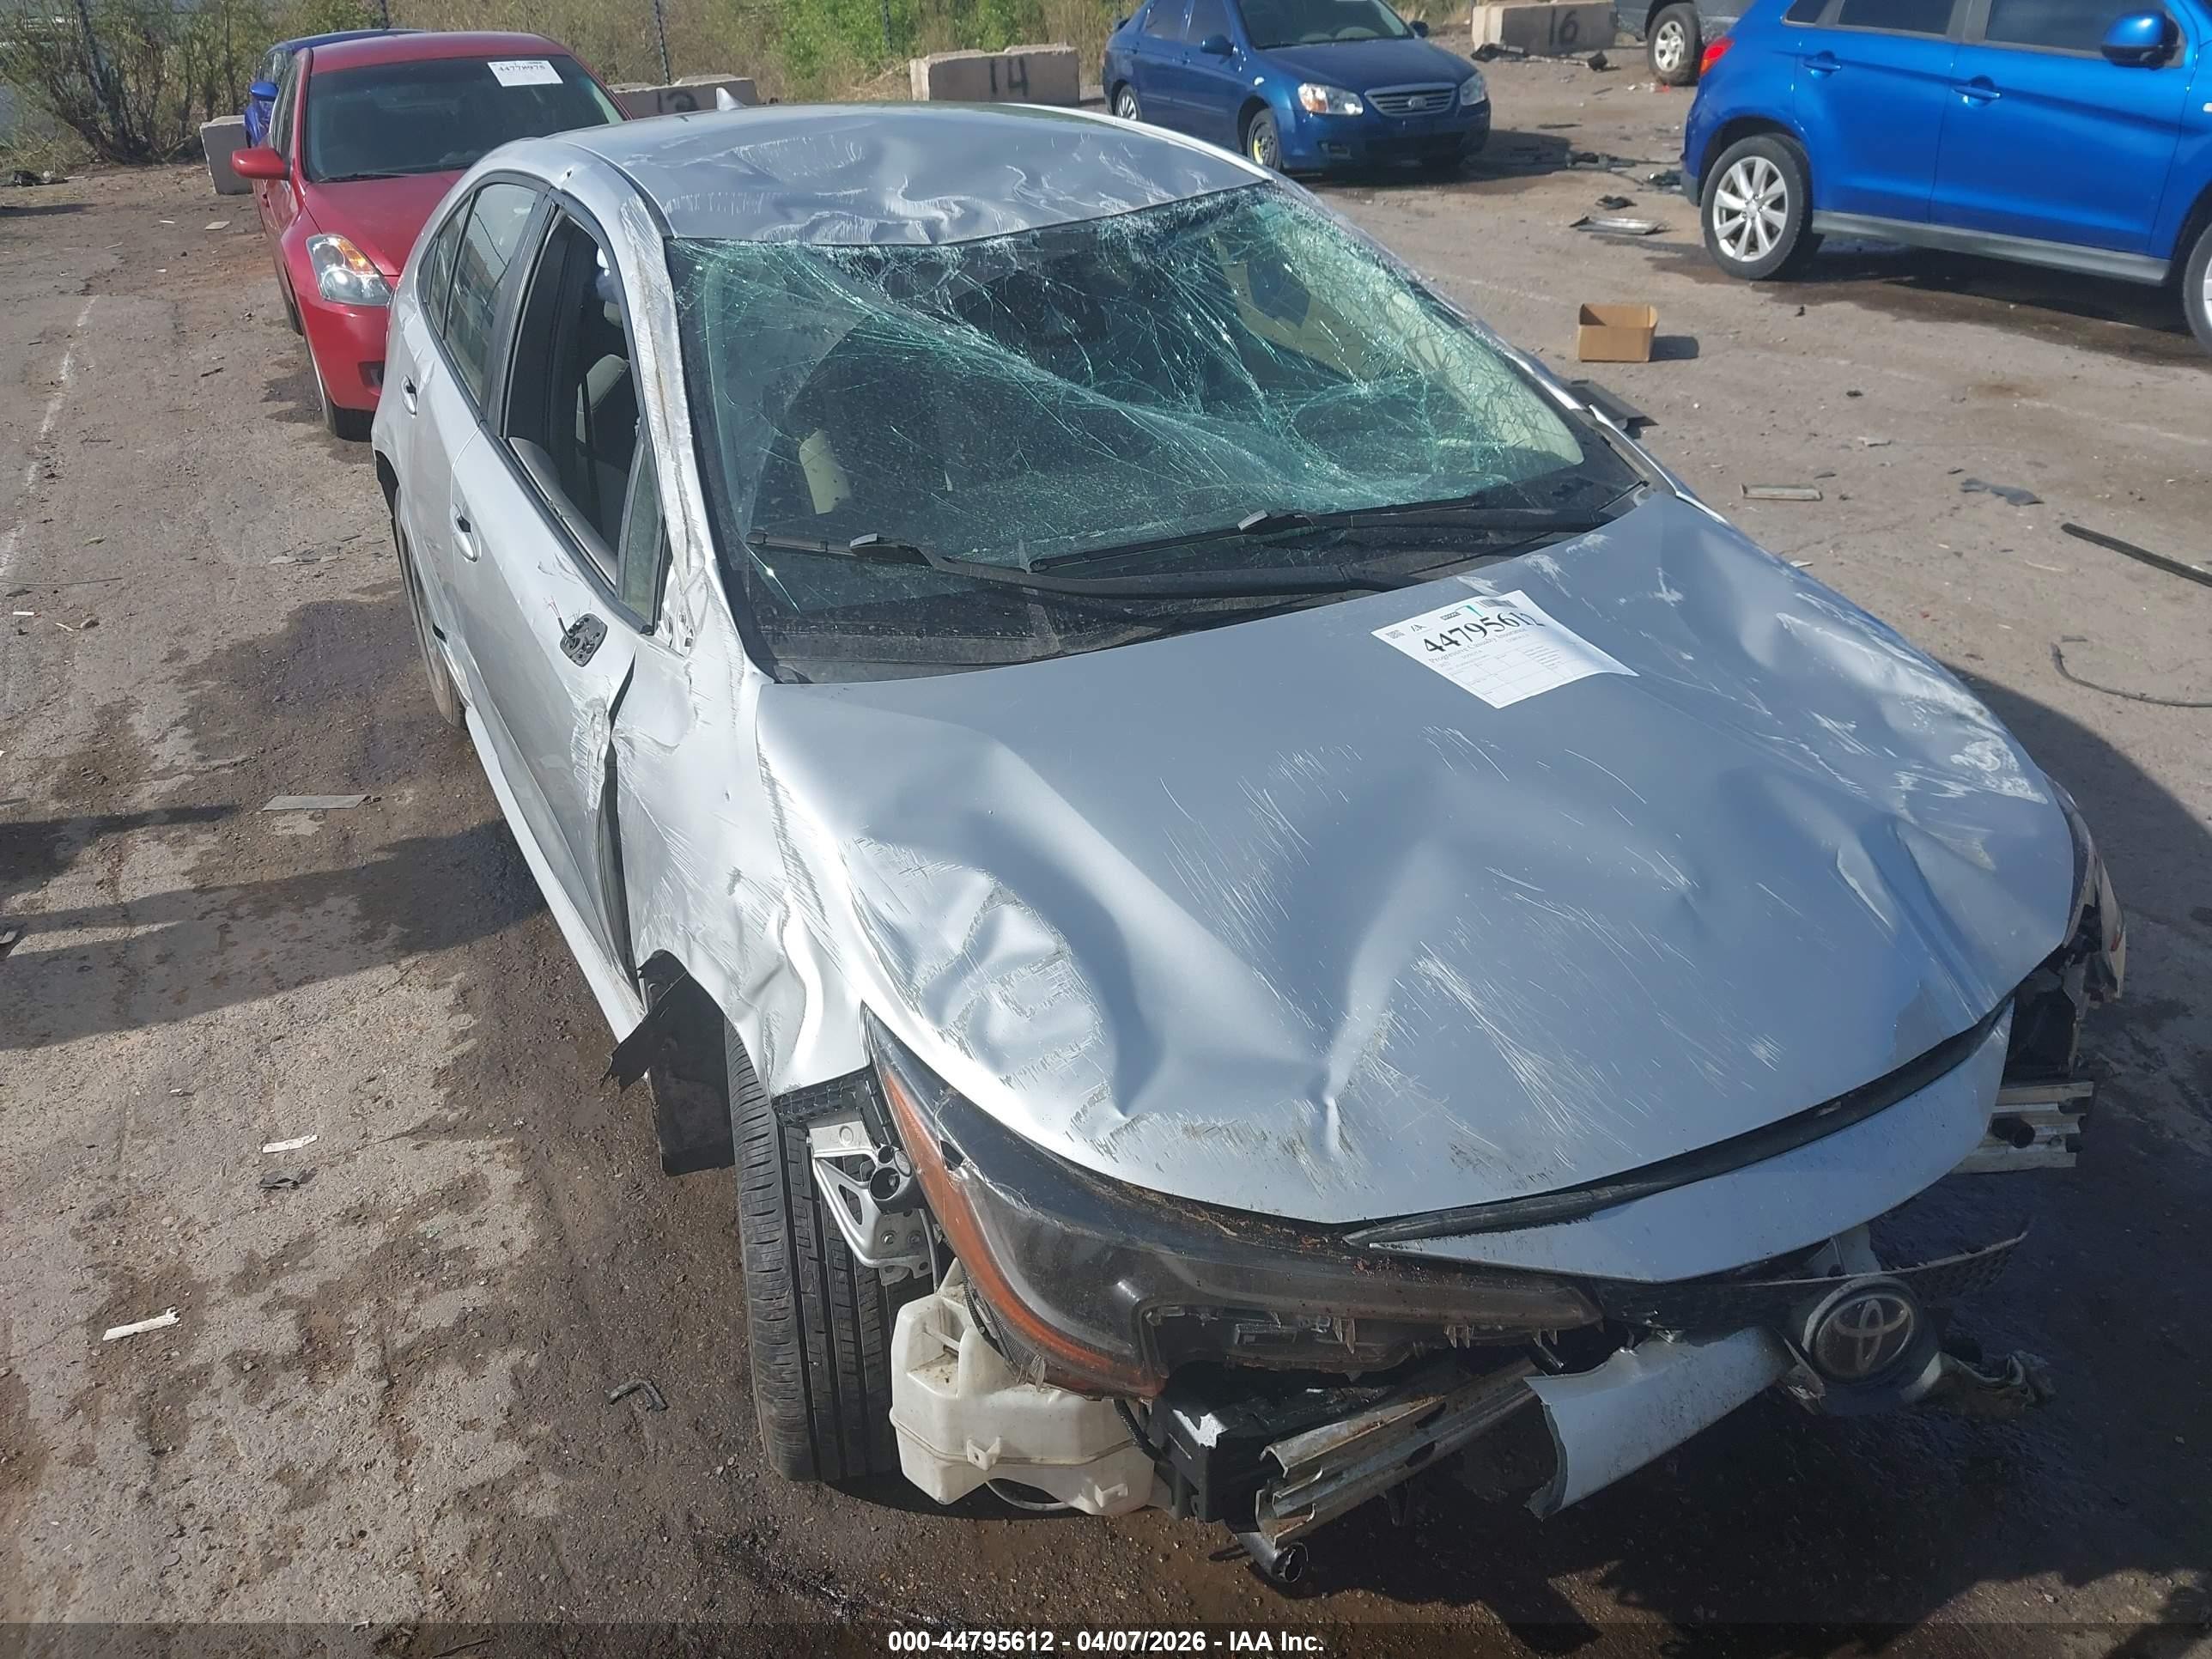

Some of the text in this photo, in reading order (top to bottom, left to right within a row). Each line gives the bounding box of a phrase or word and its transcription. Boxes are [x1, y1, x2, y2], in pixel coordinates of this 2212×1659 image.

[1548, 8, 1579, 47] 16
[989, 54, 1030, 99] 14
[1423, 611, 1547, 653] 44795612
